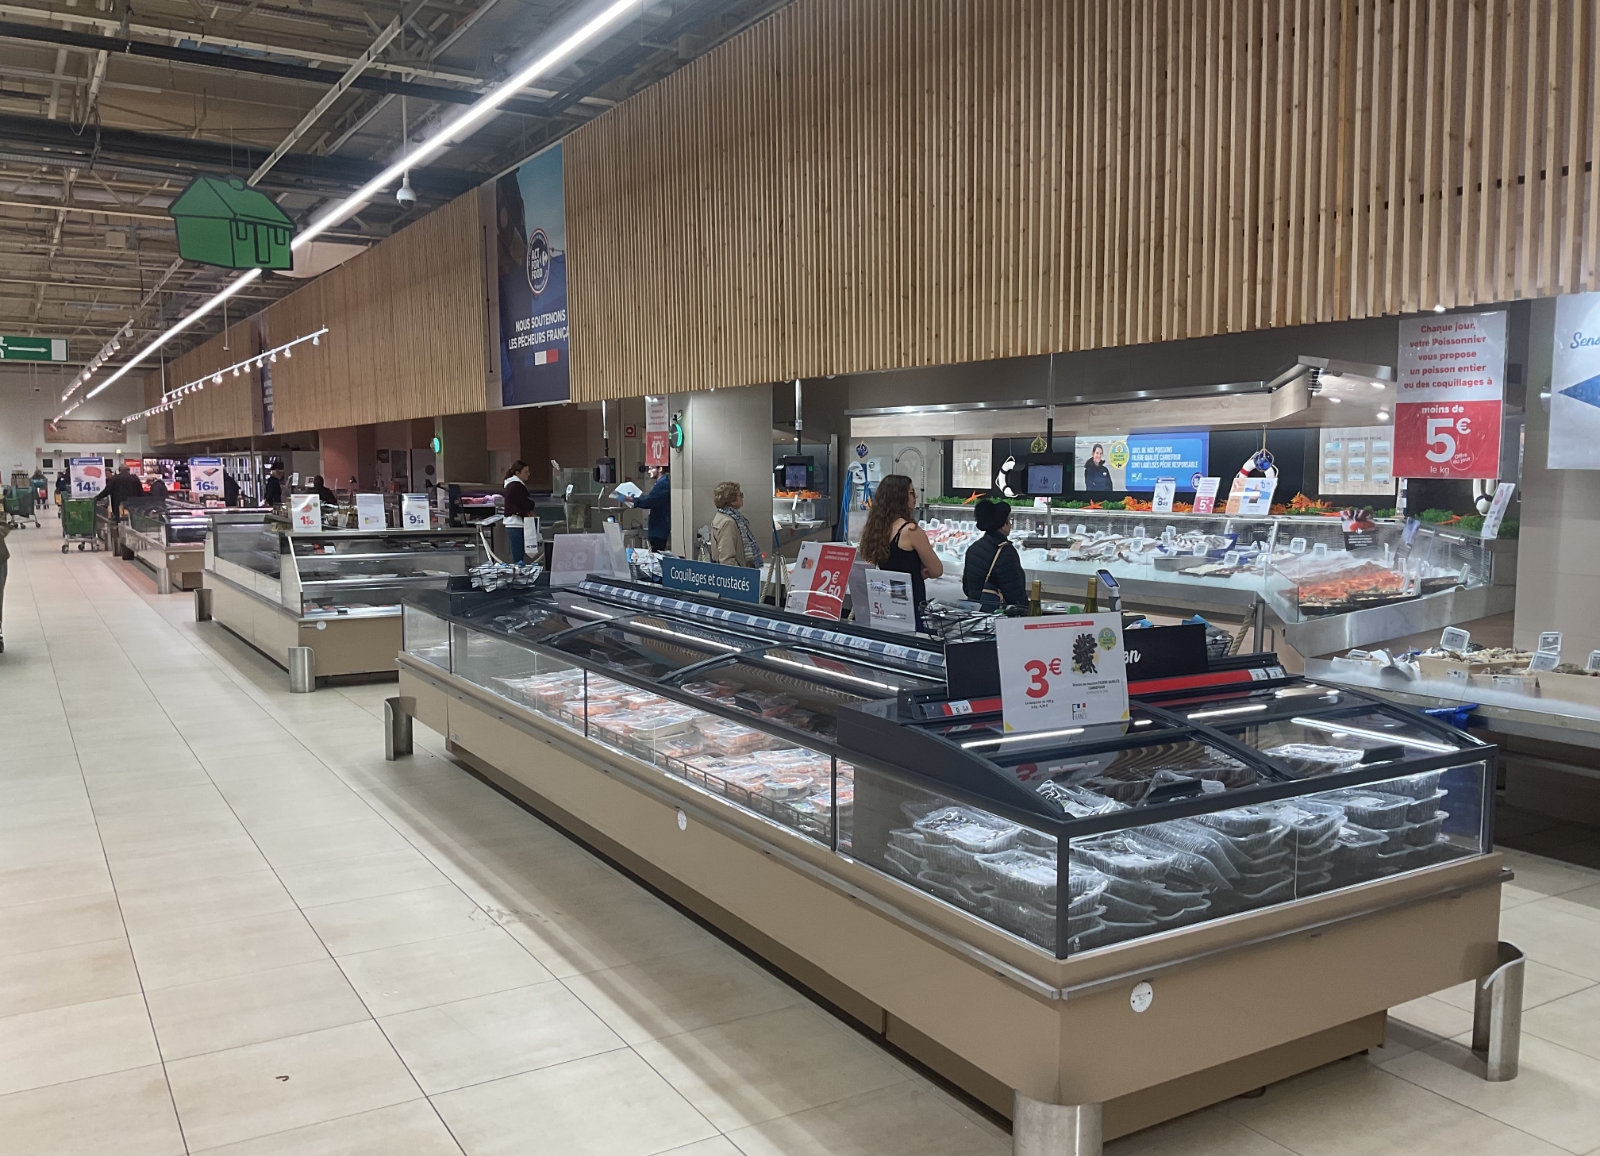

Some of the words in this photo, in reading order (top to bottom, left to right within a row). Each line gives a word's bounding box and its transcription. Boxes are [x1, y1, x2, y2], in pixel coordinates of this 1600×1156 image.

[531, 247, 540, 260] ACT
[531, 259, 540, 270] FOR
[531, 268, 543, 280] FOOD
[515, 318, 531, 332] NOUS
[531, 309, 566, 329] SOUTENONS
[1421, 324, 1453, 334] Chaque
[1455, 322, 1476, 332] jour,
[508, 338, 518, 350] LES
[517, 332, 546, 348] PÊCHEURS
[1409, 340, 1430, 348] votre
[1432, 335, 1487, 346] Poissonnier
[1440, 351, 1477, 361] propose
[1422, 366, 1456, 376] poisson
[1457, 364, 1487, 373] entier
[1416, 380, 1430, 389] des
[1432, 378, 1484, 389] coquillages
[1486, 376, 1493, 385] à
[1421, 404, 1450, 414] moins
[1451, 404, 1465, 413] de
[1430, 466, 1438, 474] le
[1440, 465, 1450, 476] kg
[670, 566, 707, 586] Coquillages
[707, 573, 716, 586] et
[716, 575, 750, 592] crustacés
